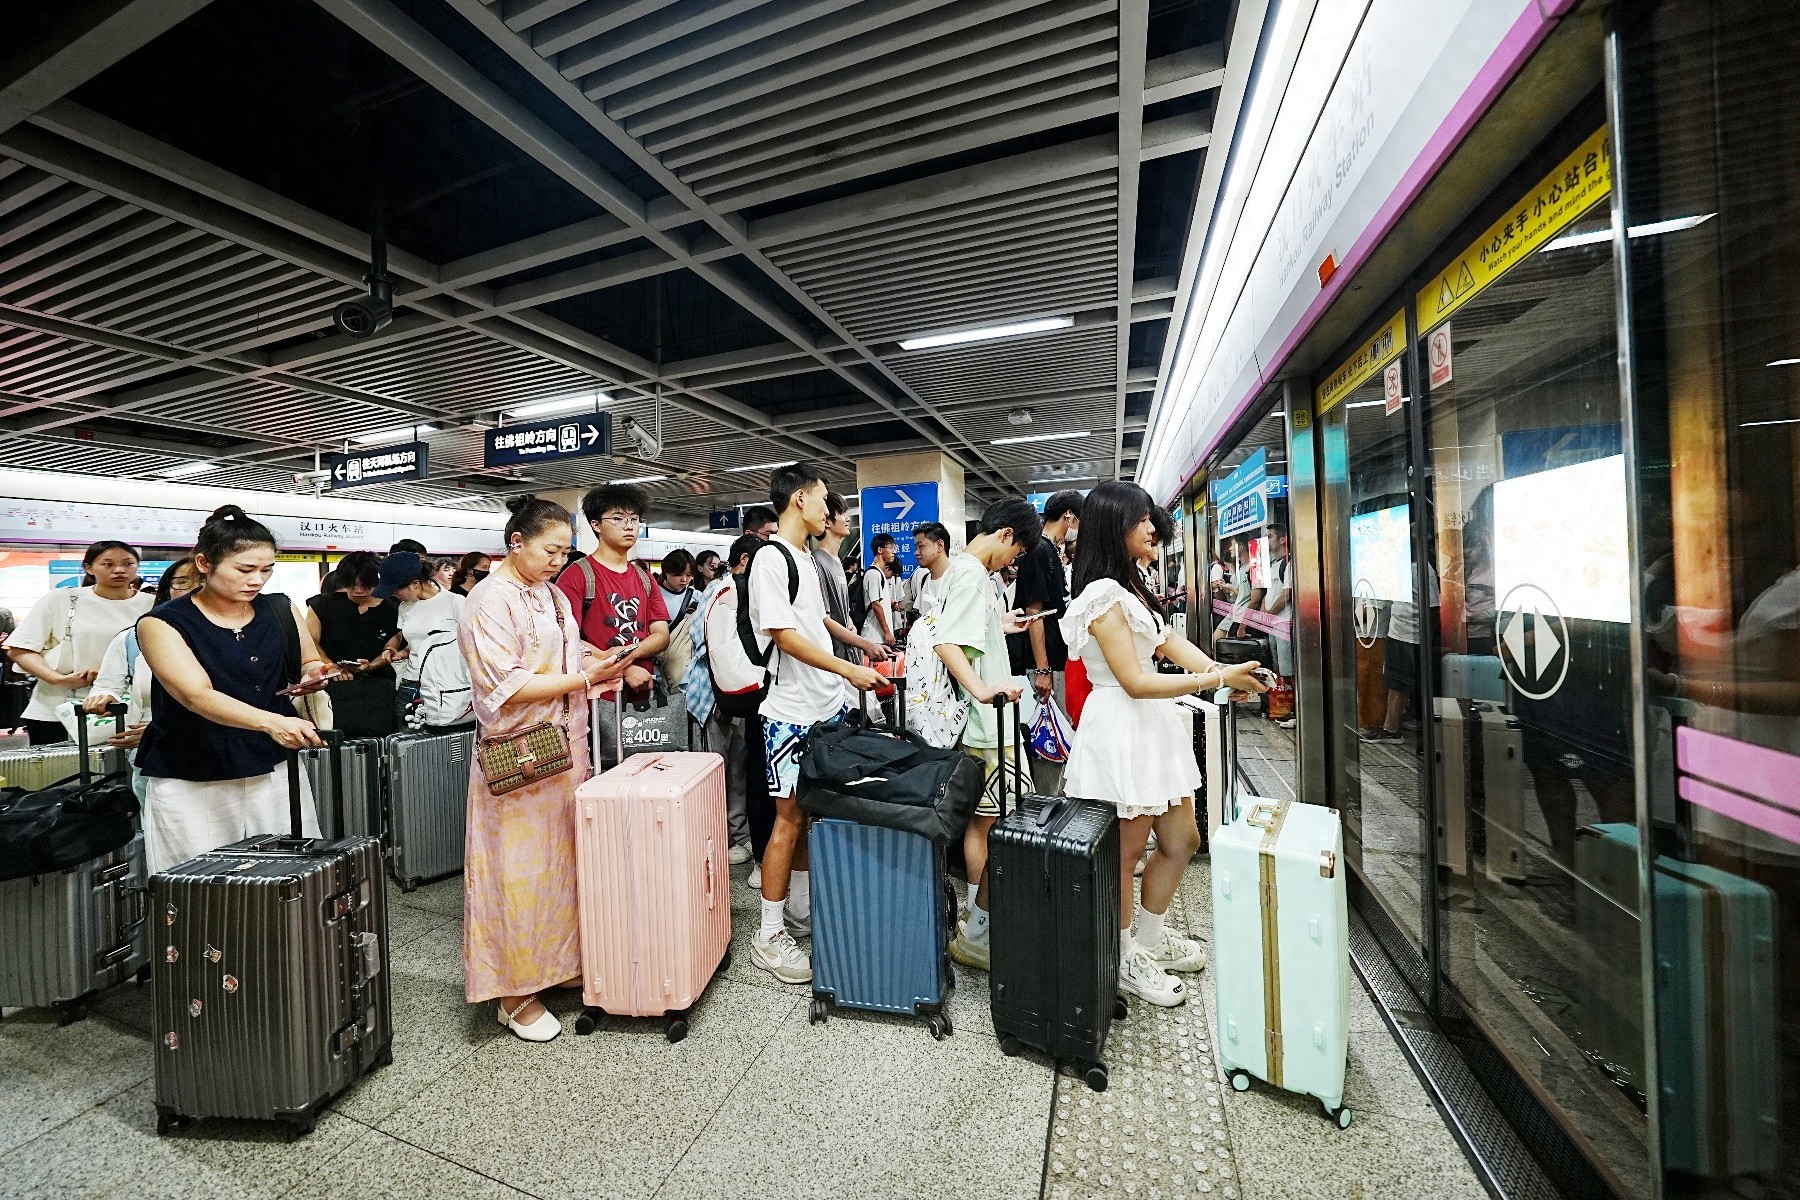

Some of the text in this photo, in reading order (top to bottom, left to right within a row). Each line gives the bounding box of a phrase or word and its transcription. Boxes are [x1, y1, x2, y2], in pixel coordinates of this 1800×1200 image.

[1278, 42, 1372, 263] 汉口火车站
[1302, 183, 1334, 248] Railway
[1335, 111, 1375, 189] Station
[1480, 208, 1529, 263] 小心夹手
[1488, 176, 1603, 271] Watch your hands and mind the
[494, 427, 557, 449] 往佛祖岭方向
[300, 521, 363, 534] 汉口火车站
